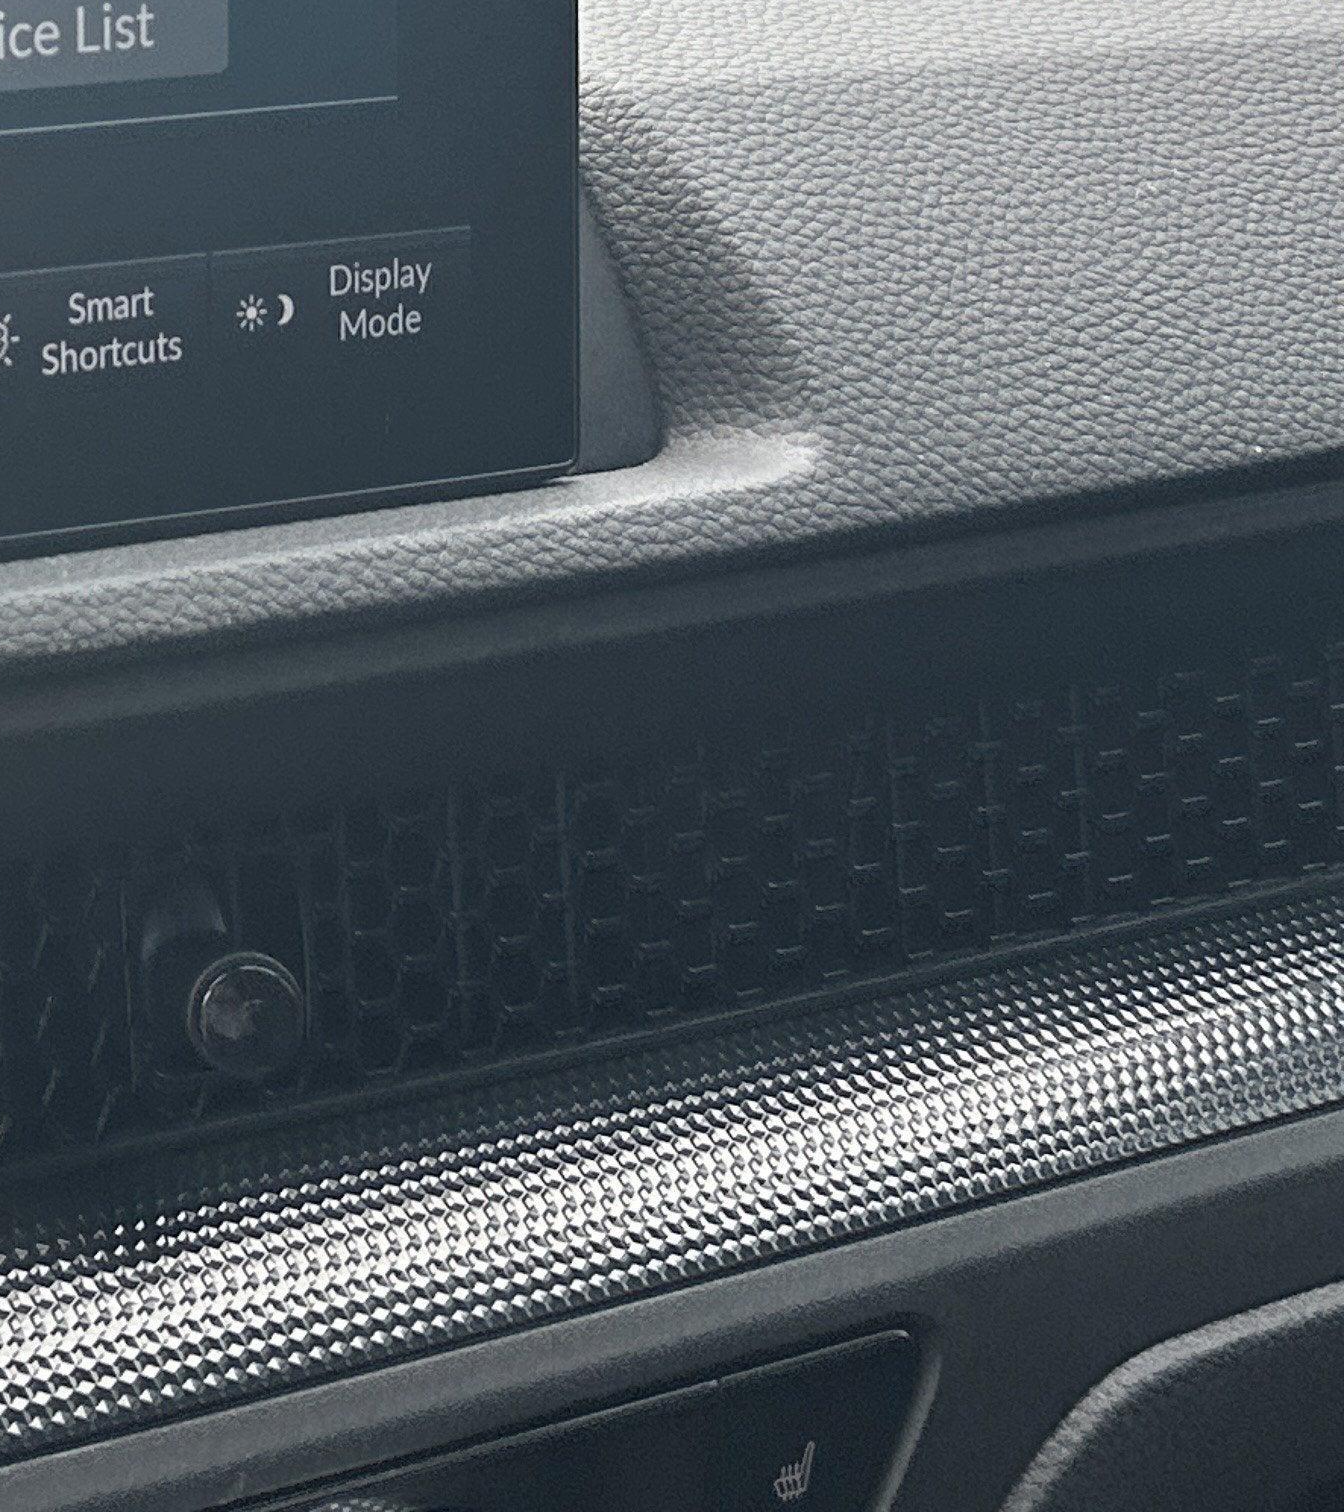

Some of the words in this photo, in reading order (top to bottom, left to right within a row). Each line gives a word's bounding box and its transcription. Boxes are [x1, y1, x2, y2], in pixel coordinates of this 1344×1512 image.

[76, 3, 155, 54] List
[329, 258, 432, 300] Display
[68, 286, 154, 326] Smart
[339, 304, 422, 341] Mode
[41, 330, 182, 375] Shortcuts
